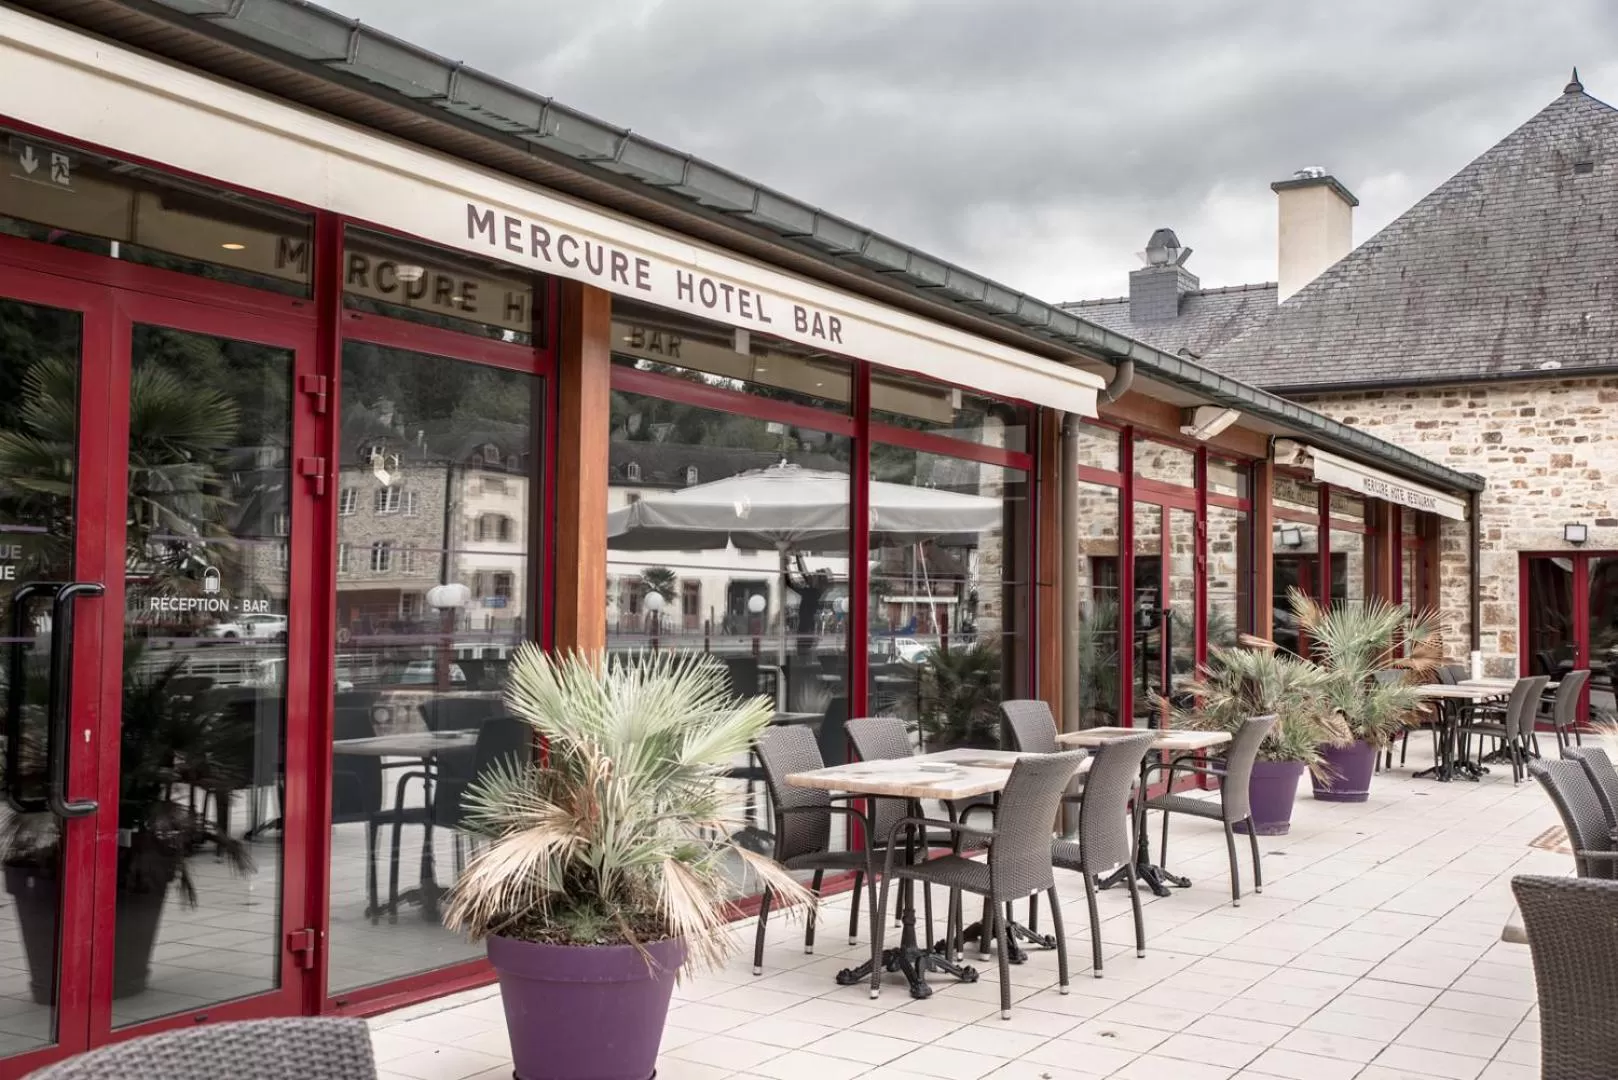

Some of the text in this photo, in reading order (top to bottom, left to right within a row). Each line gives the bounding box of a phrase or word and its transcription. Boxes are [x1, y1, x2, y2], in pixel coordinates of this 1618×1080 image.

[275, 237, 479, 312] MRCURE
[467, 203, 843, 344] MERCURE HOTEL BAR
[631, 328, 682, 358] BAR
[150, 594, 229, 612] RÉCEPTION
[243, 600, 269, 612] BAR
